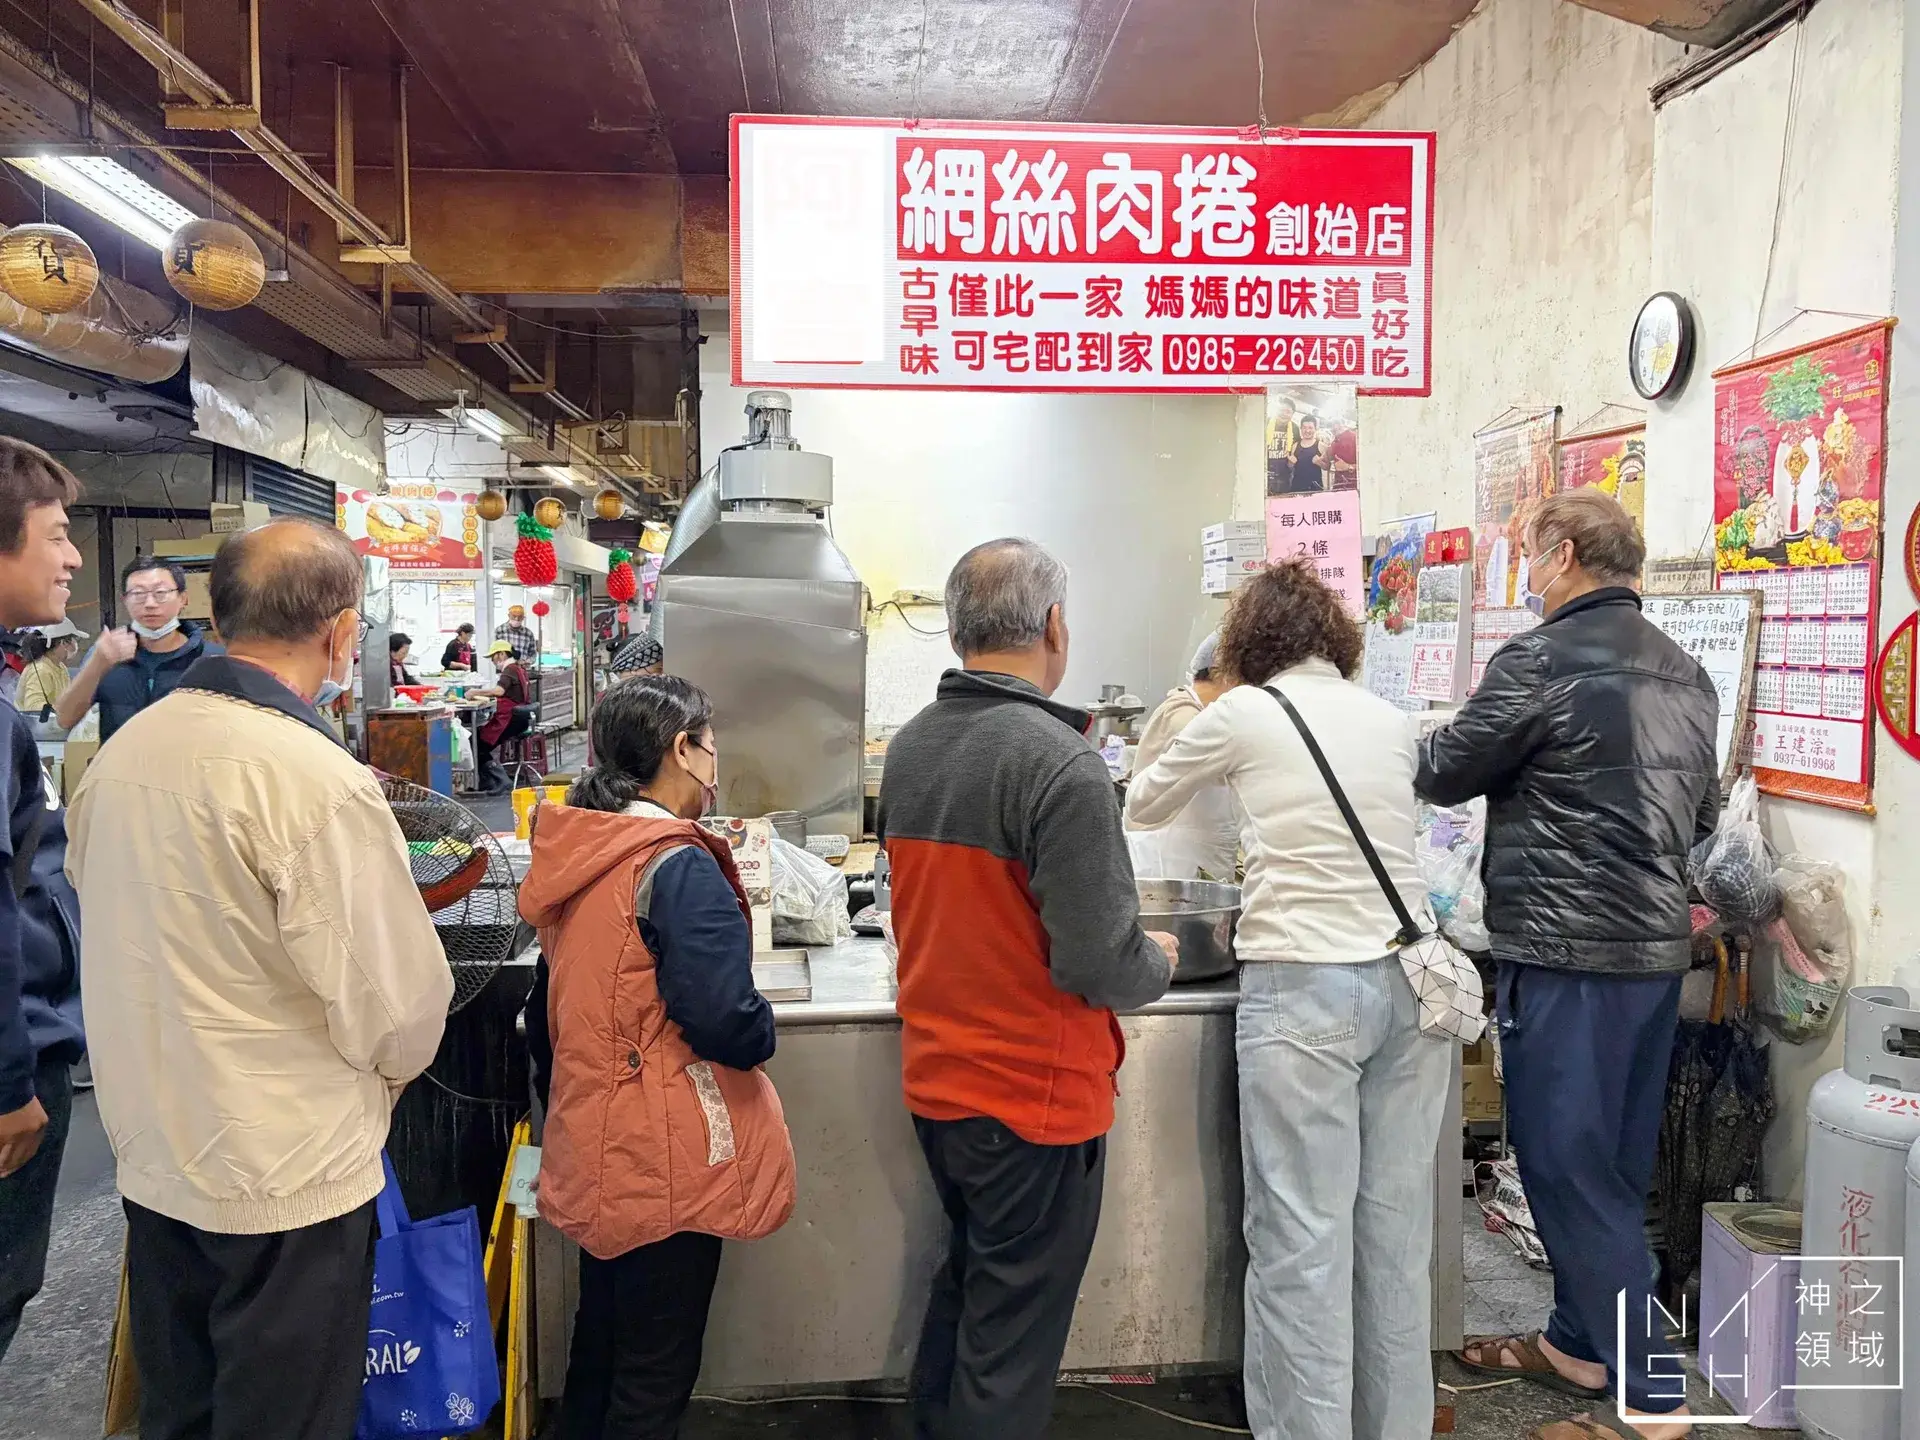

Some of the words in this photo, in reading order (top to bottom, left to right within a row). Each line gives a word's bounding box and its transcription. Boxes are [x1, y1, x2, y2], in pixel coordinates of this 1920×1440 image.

[901, 147, 1258, 259] 網絲肉捲
[1265, 201, 1407, 257] 創始店
[949, 273, 1124, 319] 僅此一家
[1145, 276, 1362, 321] 媽媽的味道
[900, 268, 939, 376] 古早味
[951, 330, 1153, 374] 可宅配到家
[1167, 336, 1358, 373] 0985-226450
[1280, 510, 1343, 528] 每人限購
[1773, 751, 1836, 771] 0937-619968
